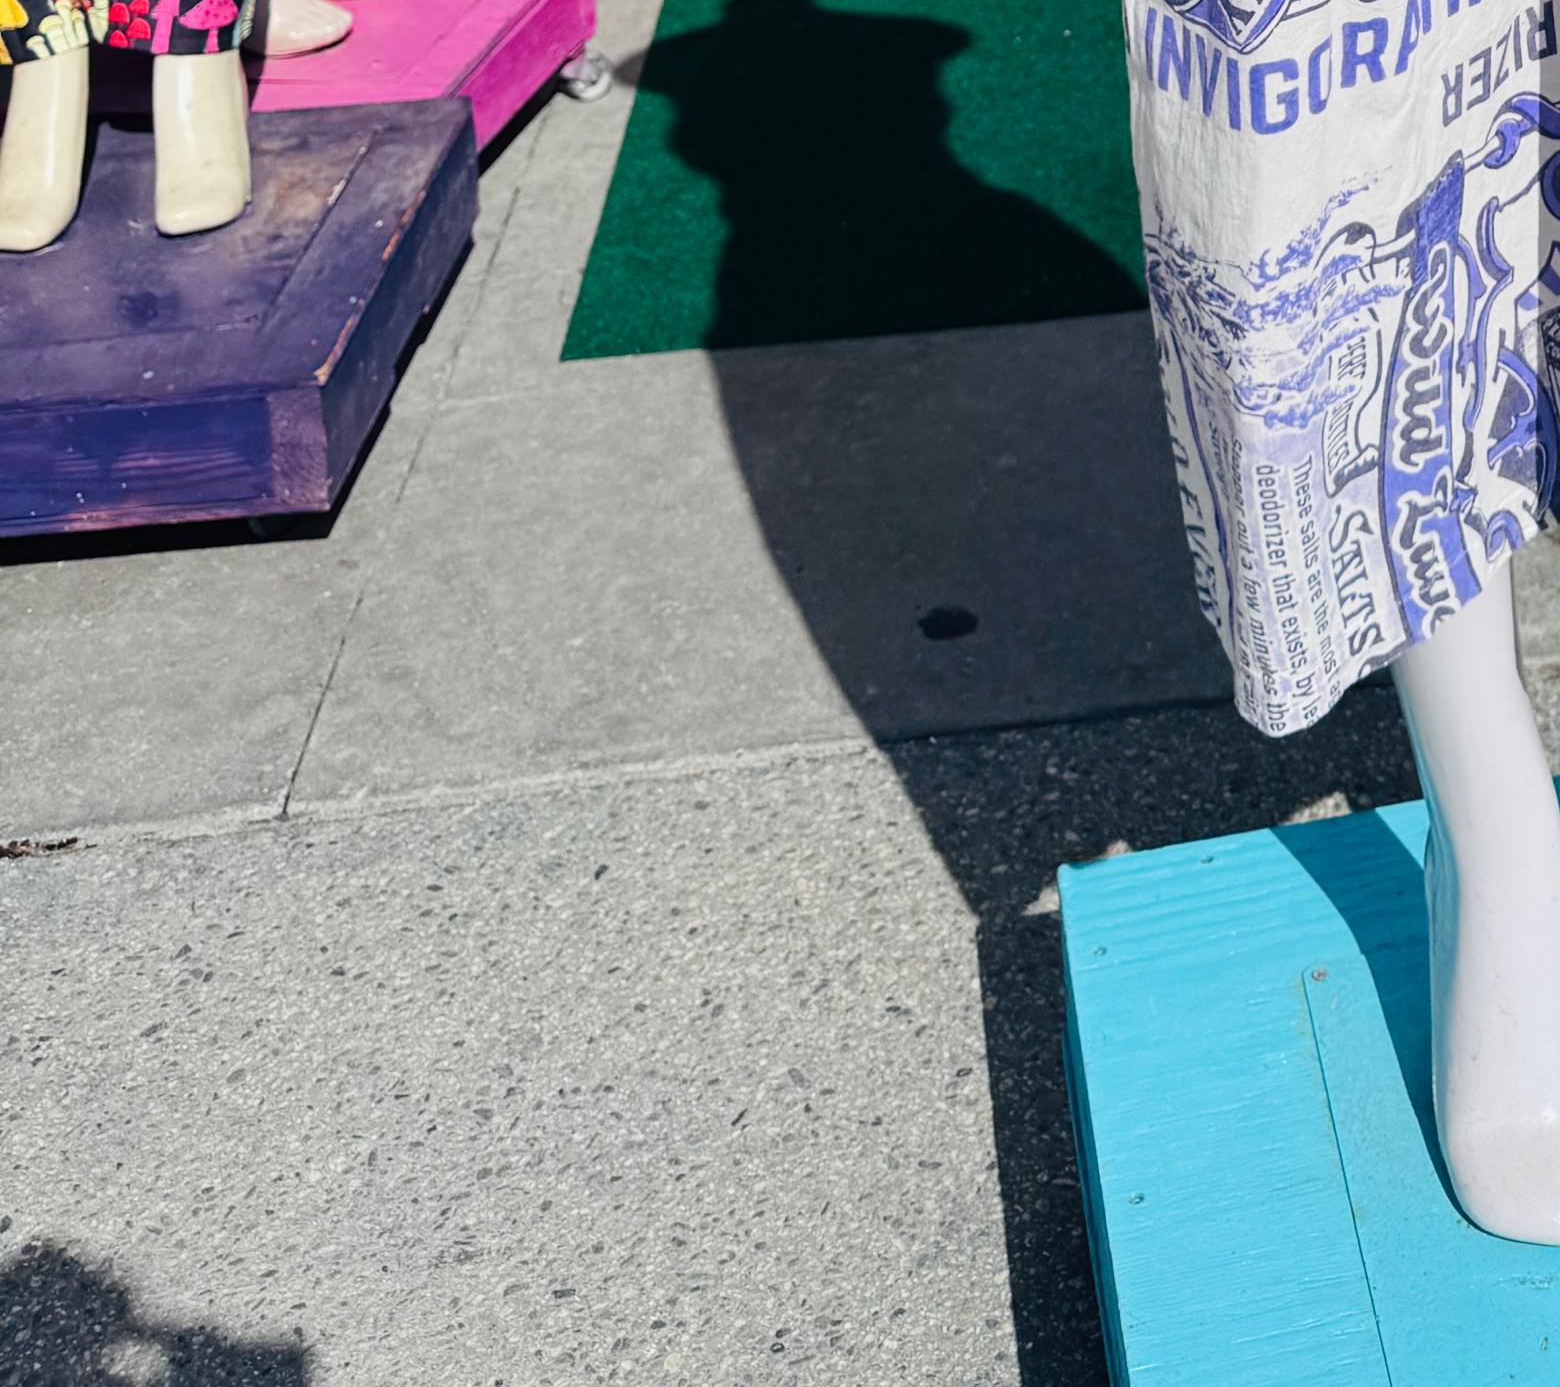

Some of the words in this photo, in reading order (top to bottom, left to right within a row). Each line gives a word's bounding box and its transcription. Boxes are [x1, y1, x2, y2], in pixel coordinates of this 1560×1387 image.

[1292, 456, 1314, 517] These
[1236, 521, 1254, 552] out
[1256, 463, 1286, 568] deodorizer
[1298, 521, 1319, 570] salts
[1242, 574, 1263, 612] few
[1272, 574, 1294, 612] that
[1307, 573, 1323, 600] are
[1328, 505, 1386, 656] SALTS
[1251, 617, 1278, 696] minutes
[1277, 617, 1308, 674] exists,
[1292, 675, 1316, 698] by
